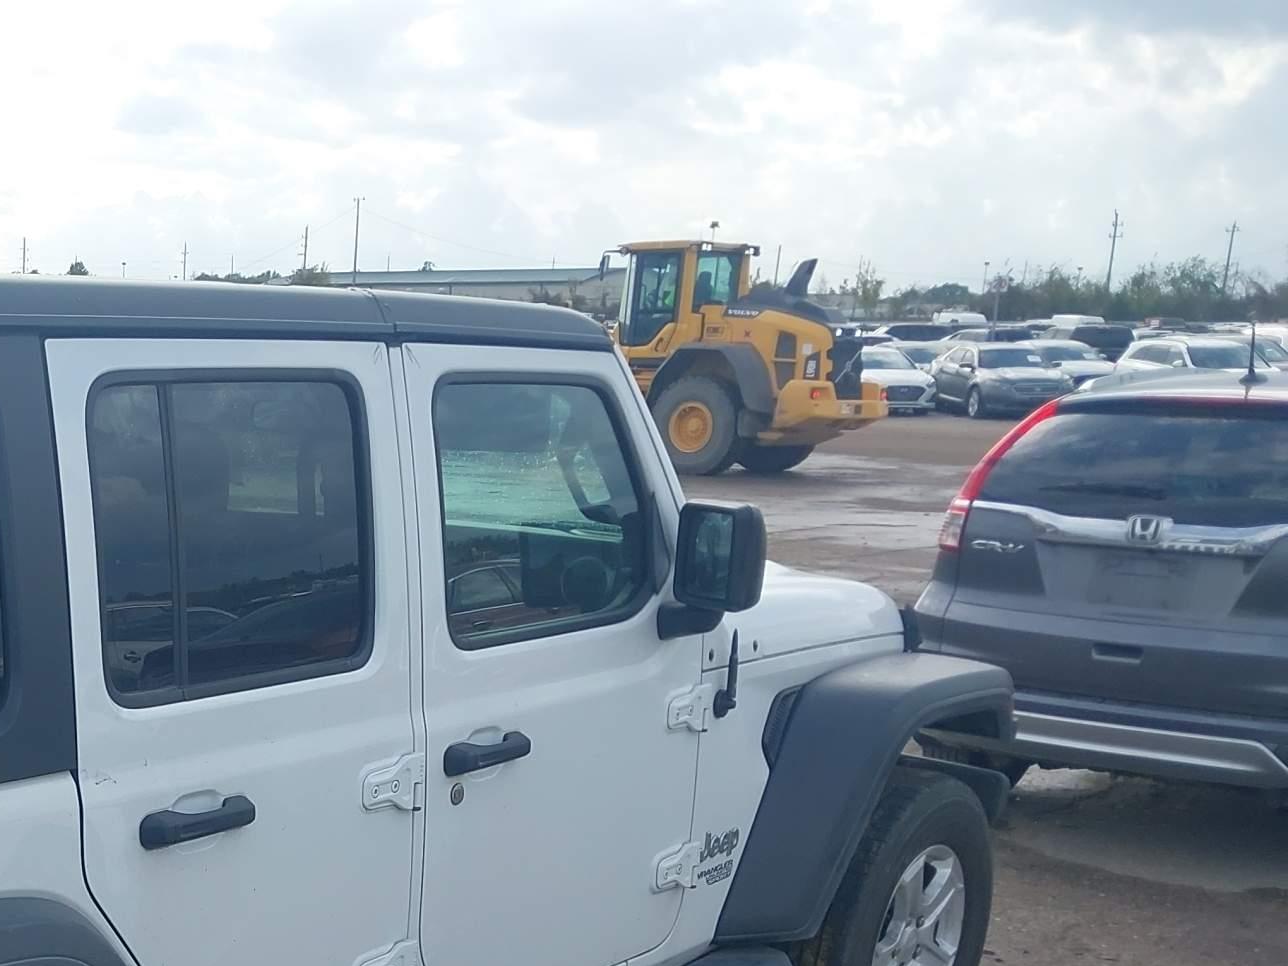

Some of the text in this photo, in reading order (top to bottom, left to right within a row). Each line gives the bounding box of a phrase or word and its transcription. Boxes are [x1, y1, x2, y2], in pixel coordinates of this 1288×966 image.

[727, 308, 760, 317] VOLVO
[700, 828, 739, 863] Jeep
[697, 859, 734, 879] WRANGLER
